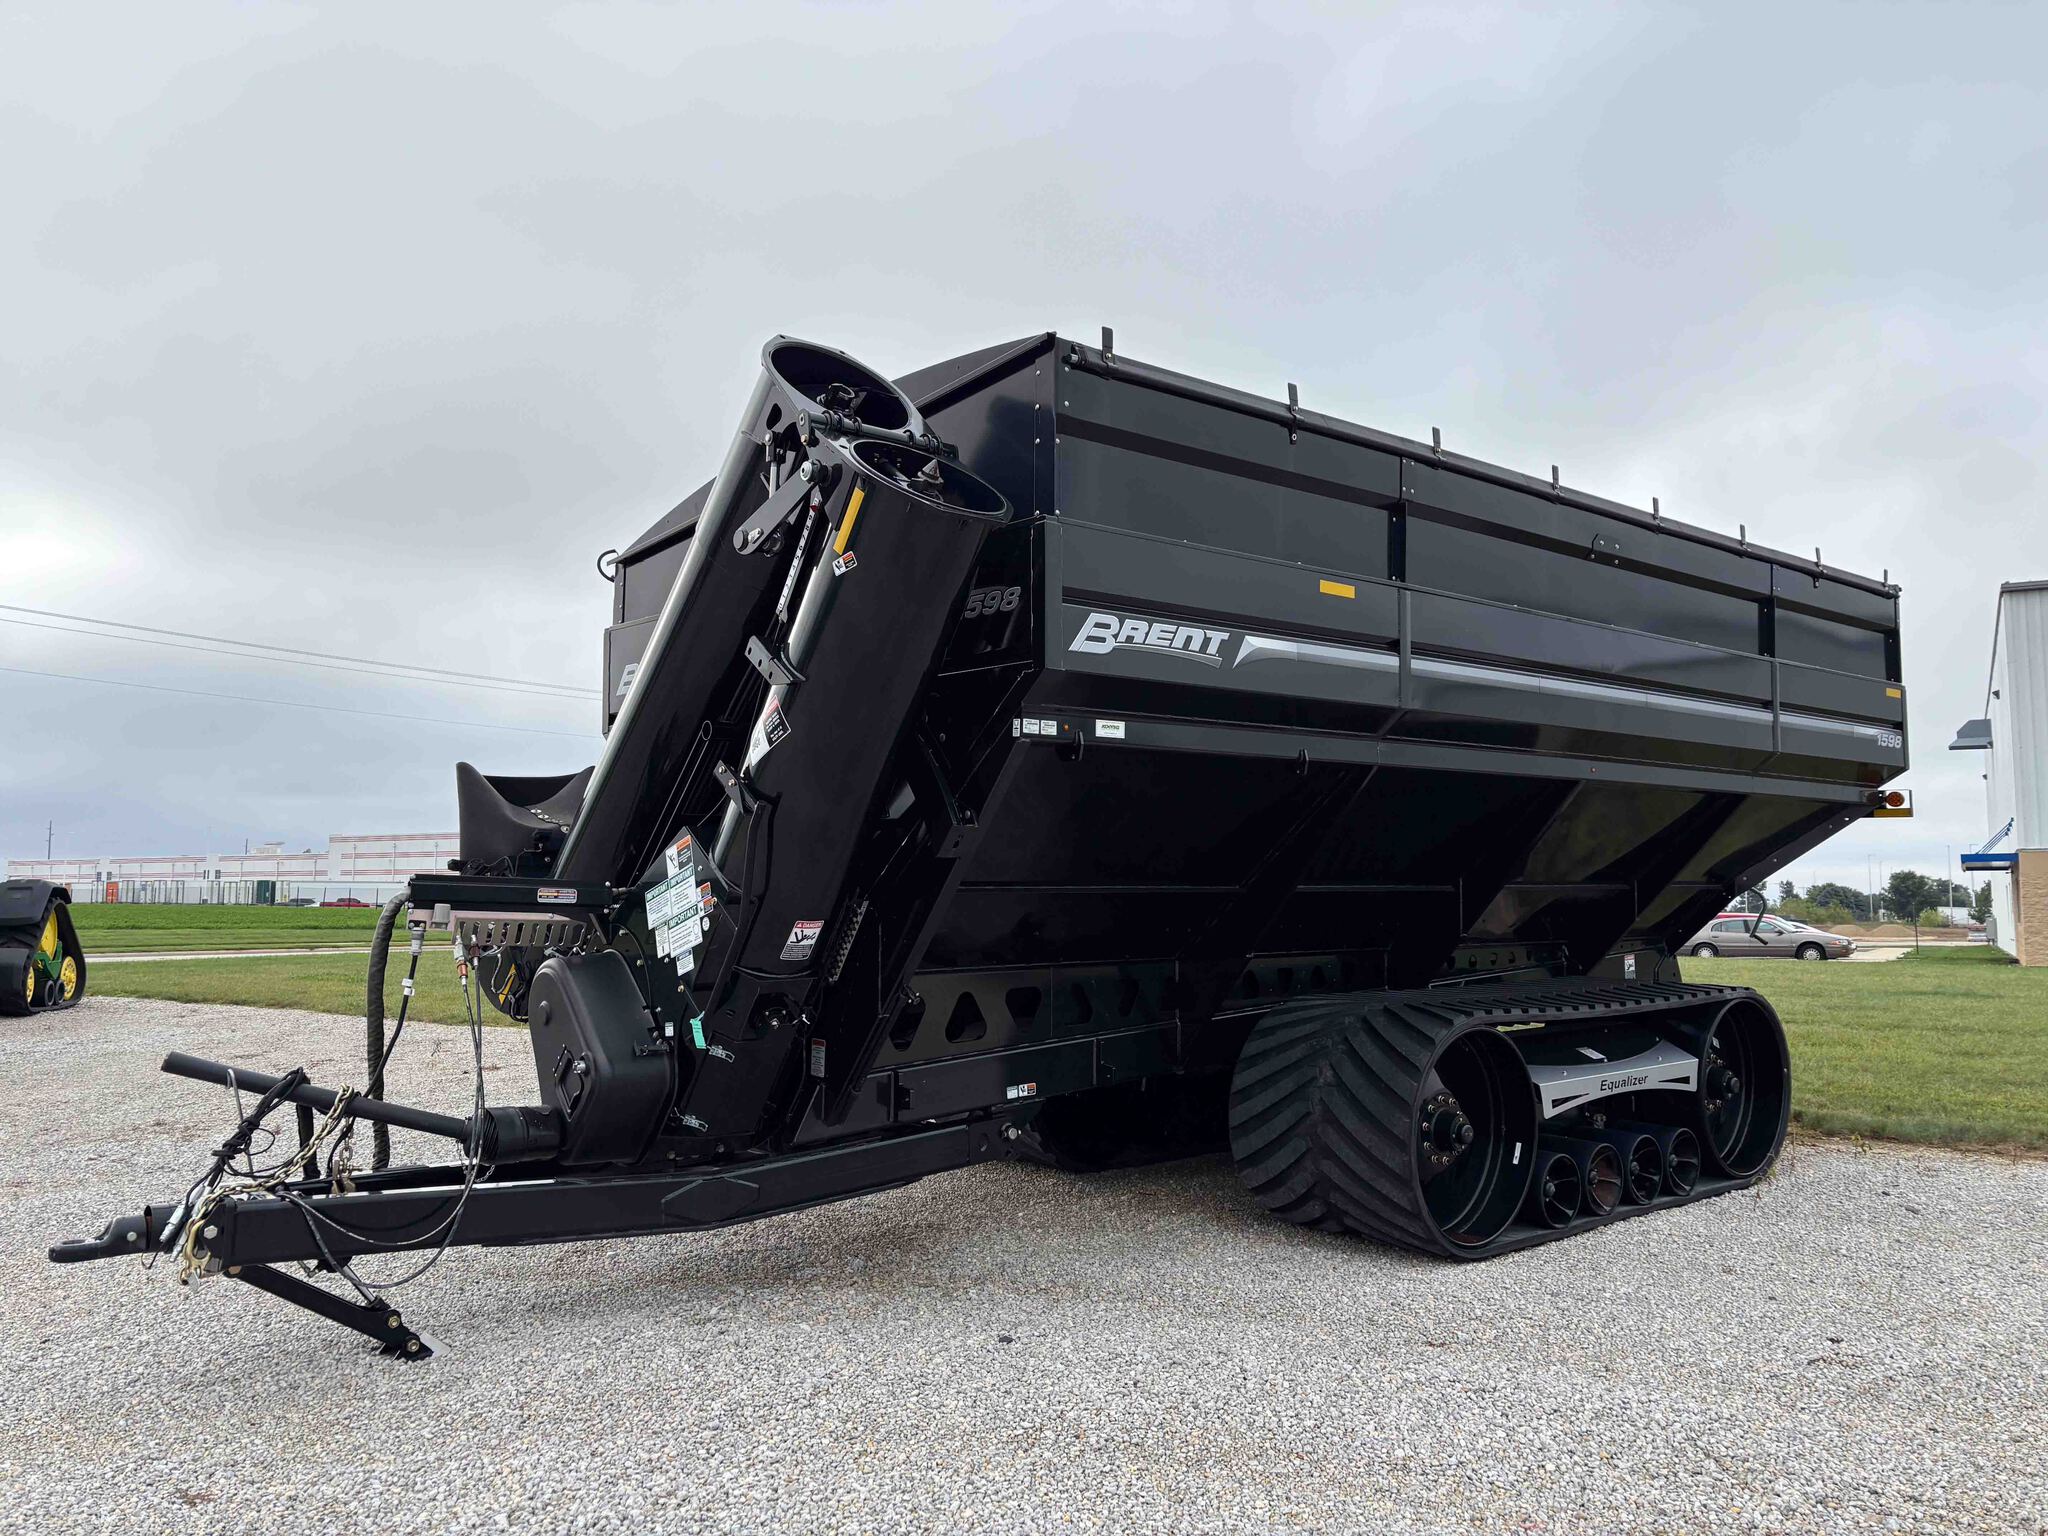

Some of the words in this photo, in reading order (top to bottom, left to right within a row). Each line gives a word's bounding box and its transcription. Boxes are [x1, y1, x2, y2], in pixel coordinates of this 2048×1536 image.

[964, 586, 1021, 618] 598
[1068, 612, 1230, 655] BRENT
[1877, 732, 1903, 748] 1598
[668, 906, 698, 928] IMPORTANT
[1600, 1075, 1649, 1092] Equalizer
